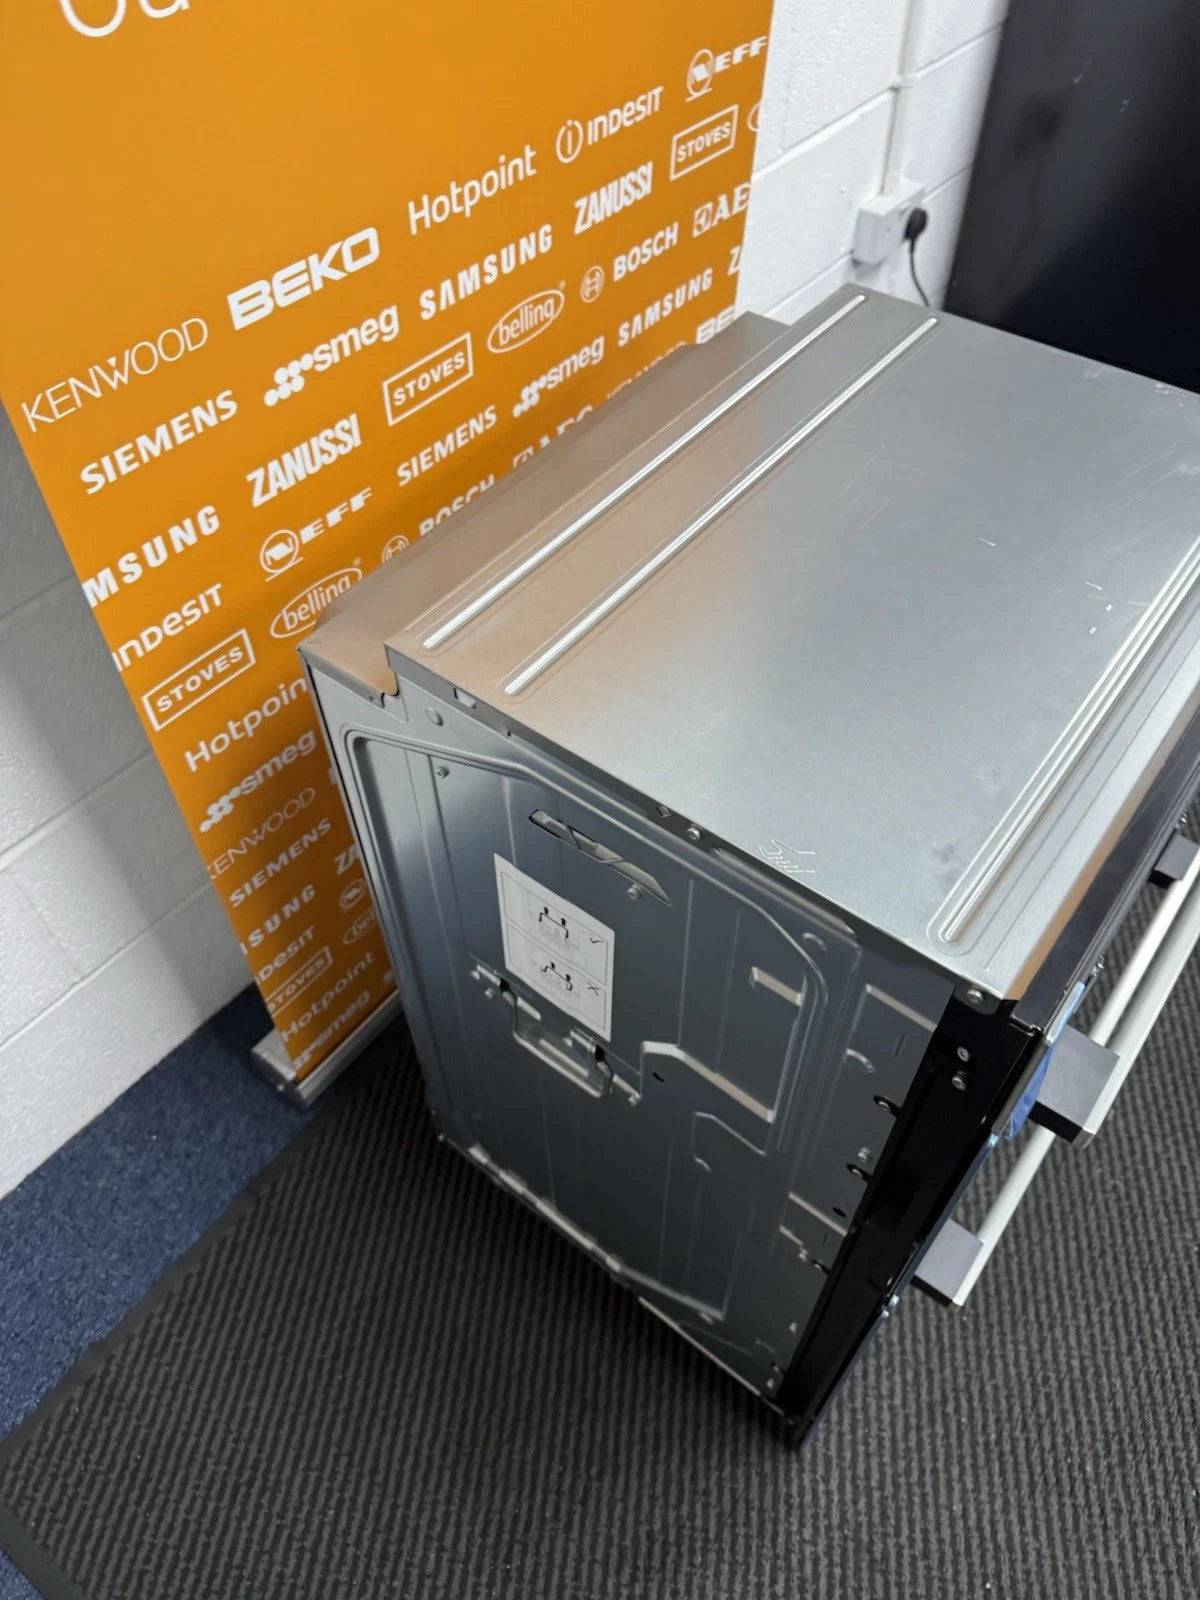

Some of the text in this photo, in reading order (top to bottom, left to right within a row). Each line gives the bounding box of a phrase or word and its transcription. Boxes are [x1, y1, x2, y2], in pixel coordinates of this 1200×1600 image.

[686, 35, 767, 92] NEFF
[677, 120, 731, 163] STOVES
[407, 144, 537, 235] Hotpoint
[573, 161, 653, 235] ZANUSSI
[226, 226, 380, 331] BEKO
[419, 223, 553, 319] SAMSUNG
[613, 222, 679, 282] BOSCH
[313, 304, 400, 372] smeg
[617, 267, 713, 347] SAMSUNG
[21, 316, 209, 433] KENWOOD
[393, 353, 466, 407] STOVES
[546, 335, 604, 389] smeg
[80, 389, 238, 495] SIEMENS
[245, 413, 362, 508] ZANUSSI
[396, 404, 498, 487] SIEMENS
[82, 505, 221, 608] MSUNG
[264, 486, 372, 568] NEFF
[157, 645, 244, 713] STOVES
[240, 731, 316, 795] smeg
[230, 817, 331, 908] SIEMENS
[282, 951, 374, 1043] Hotpoint
